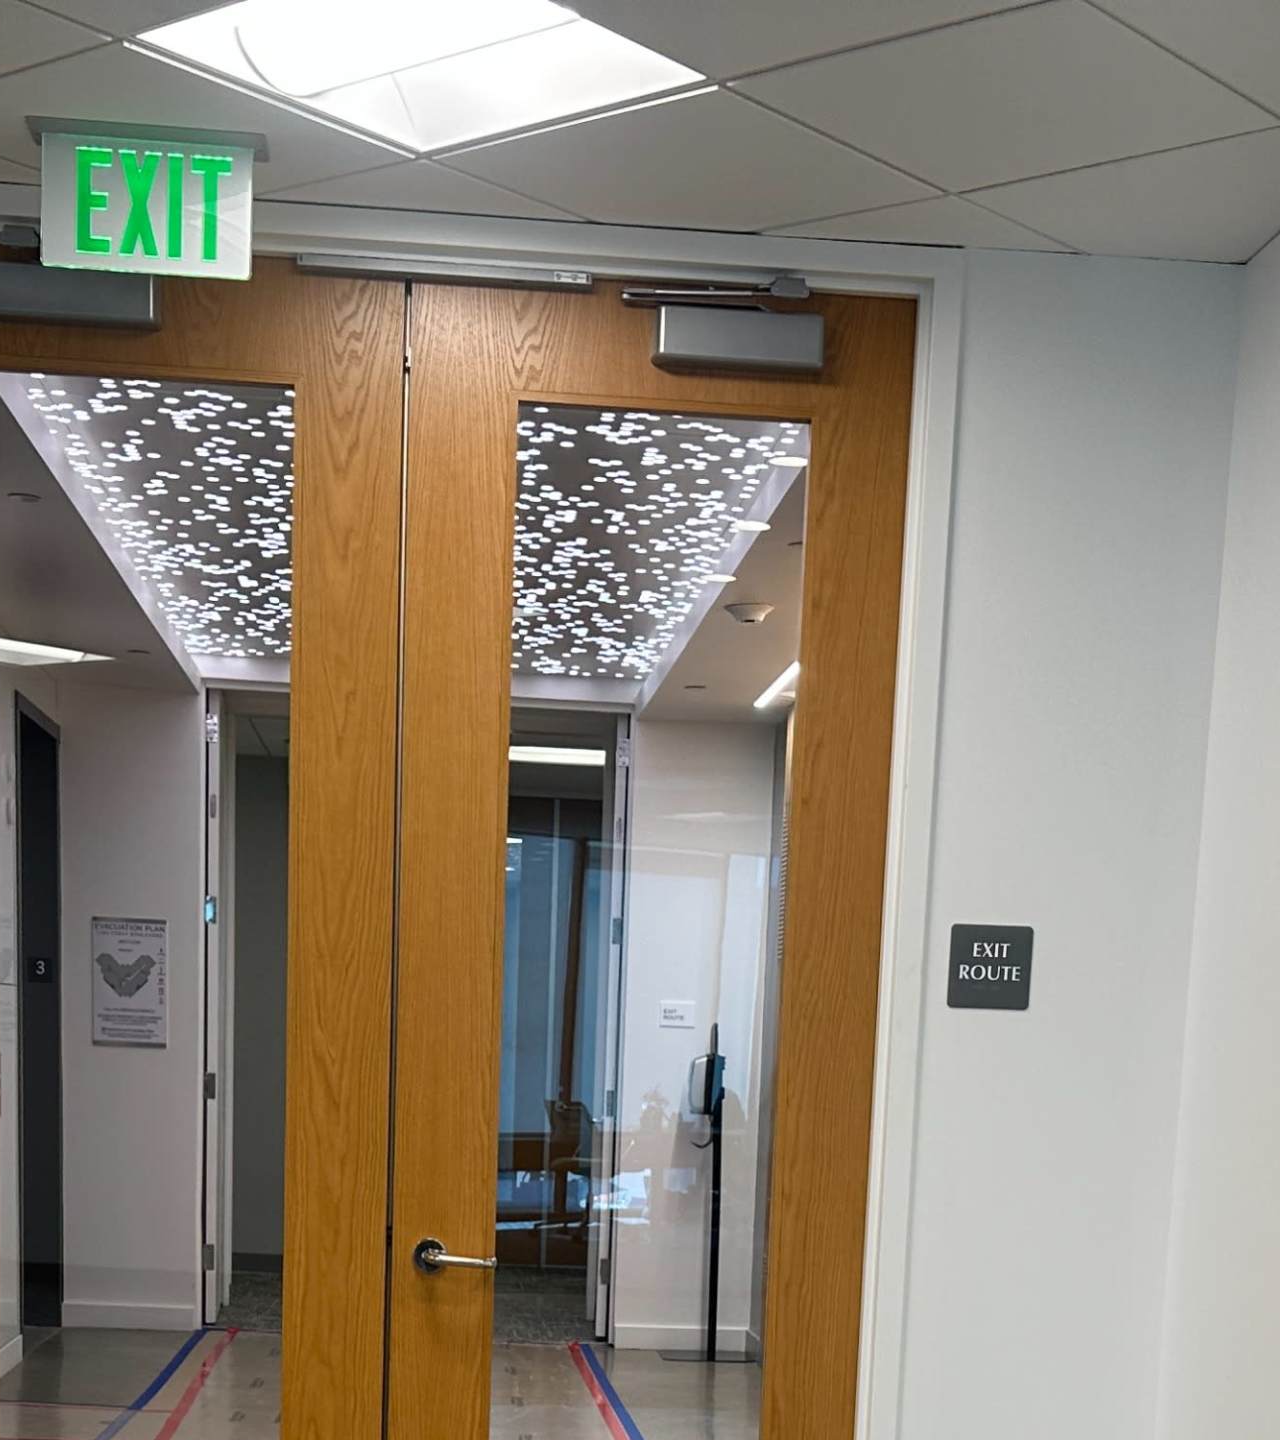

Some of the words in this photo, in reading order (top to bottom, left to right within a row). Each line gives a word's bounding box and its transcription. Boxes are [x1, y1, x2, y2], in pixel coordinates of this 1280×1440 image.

[75, 146, 233, 262] EXIT
[972, 942, 1011, 958] EXIT
[35, 960, 45, 975] 3
[958, 964, 1021, 981] ROUTE
